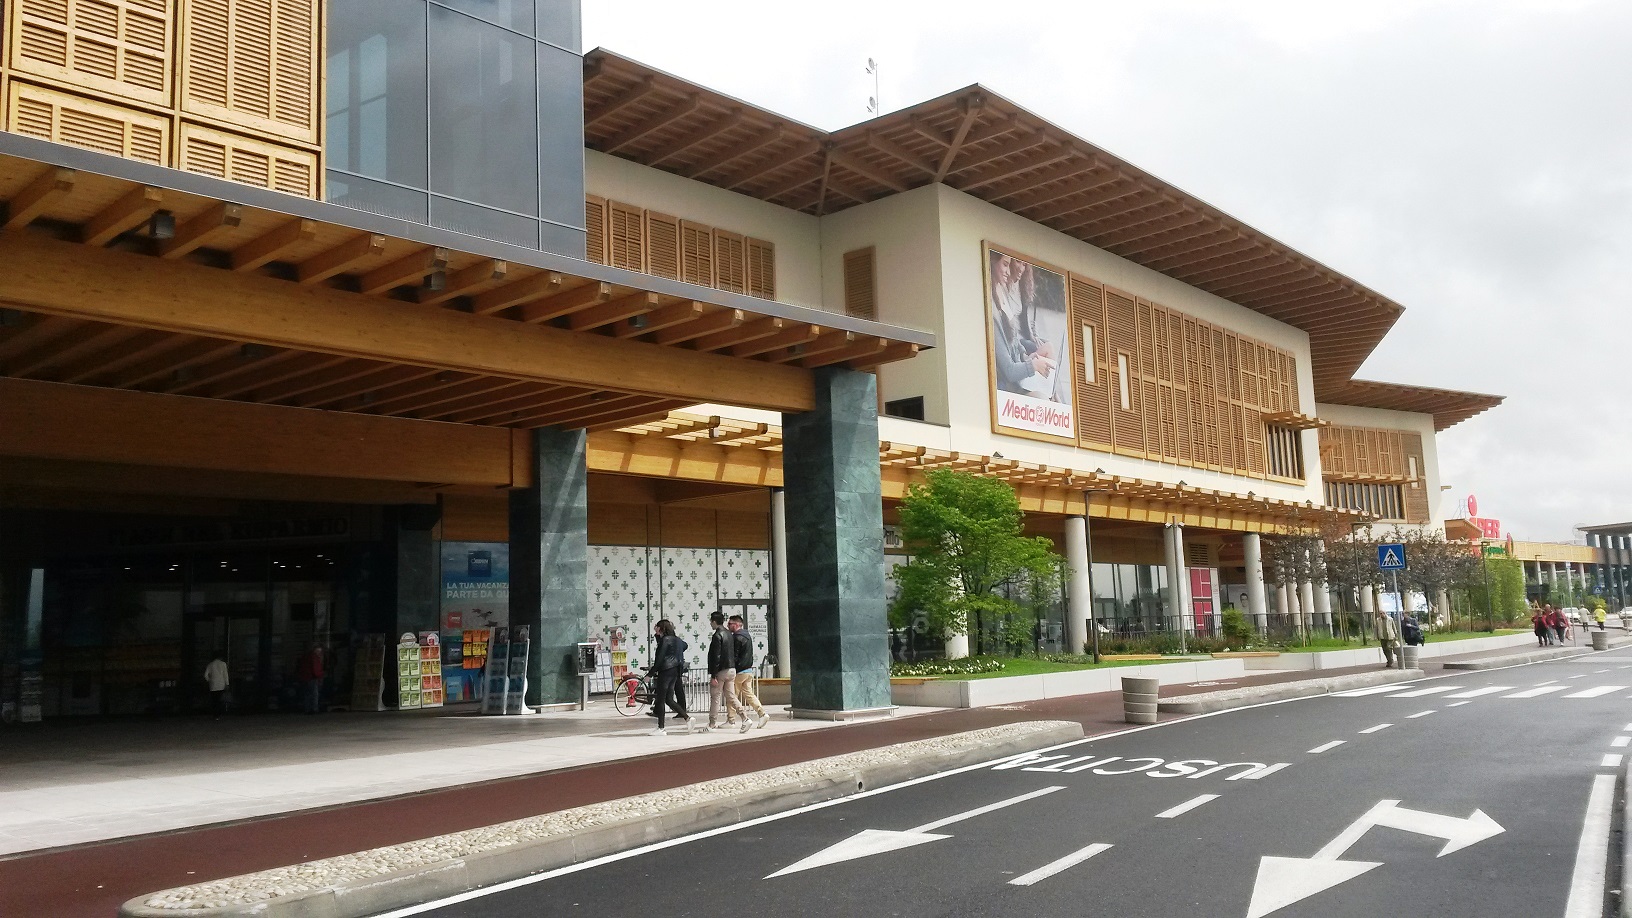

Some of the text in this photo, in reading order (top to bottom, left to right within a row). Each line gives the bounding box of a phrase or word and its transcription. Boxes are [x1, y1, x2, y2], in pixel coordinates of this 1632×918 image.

[1002, 399, 1069, 428] Media World
[447, 590, 478, 599] PARTE
[480, 590, 494, 599] DA
